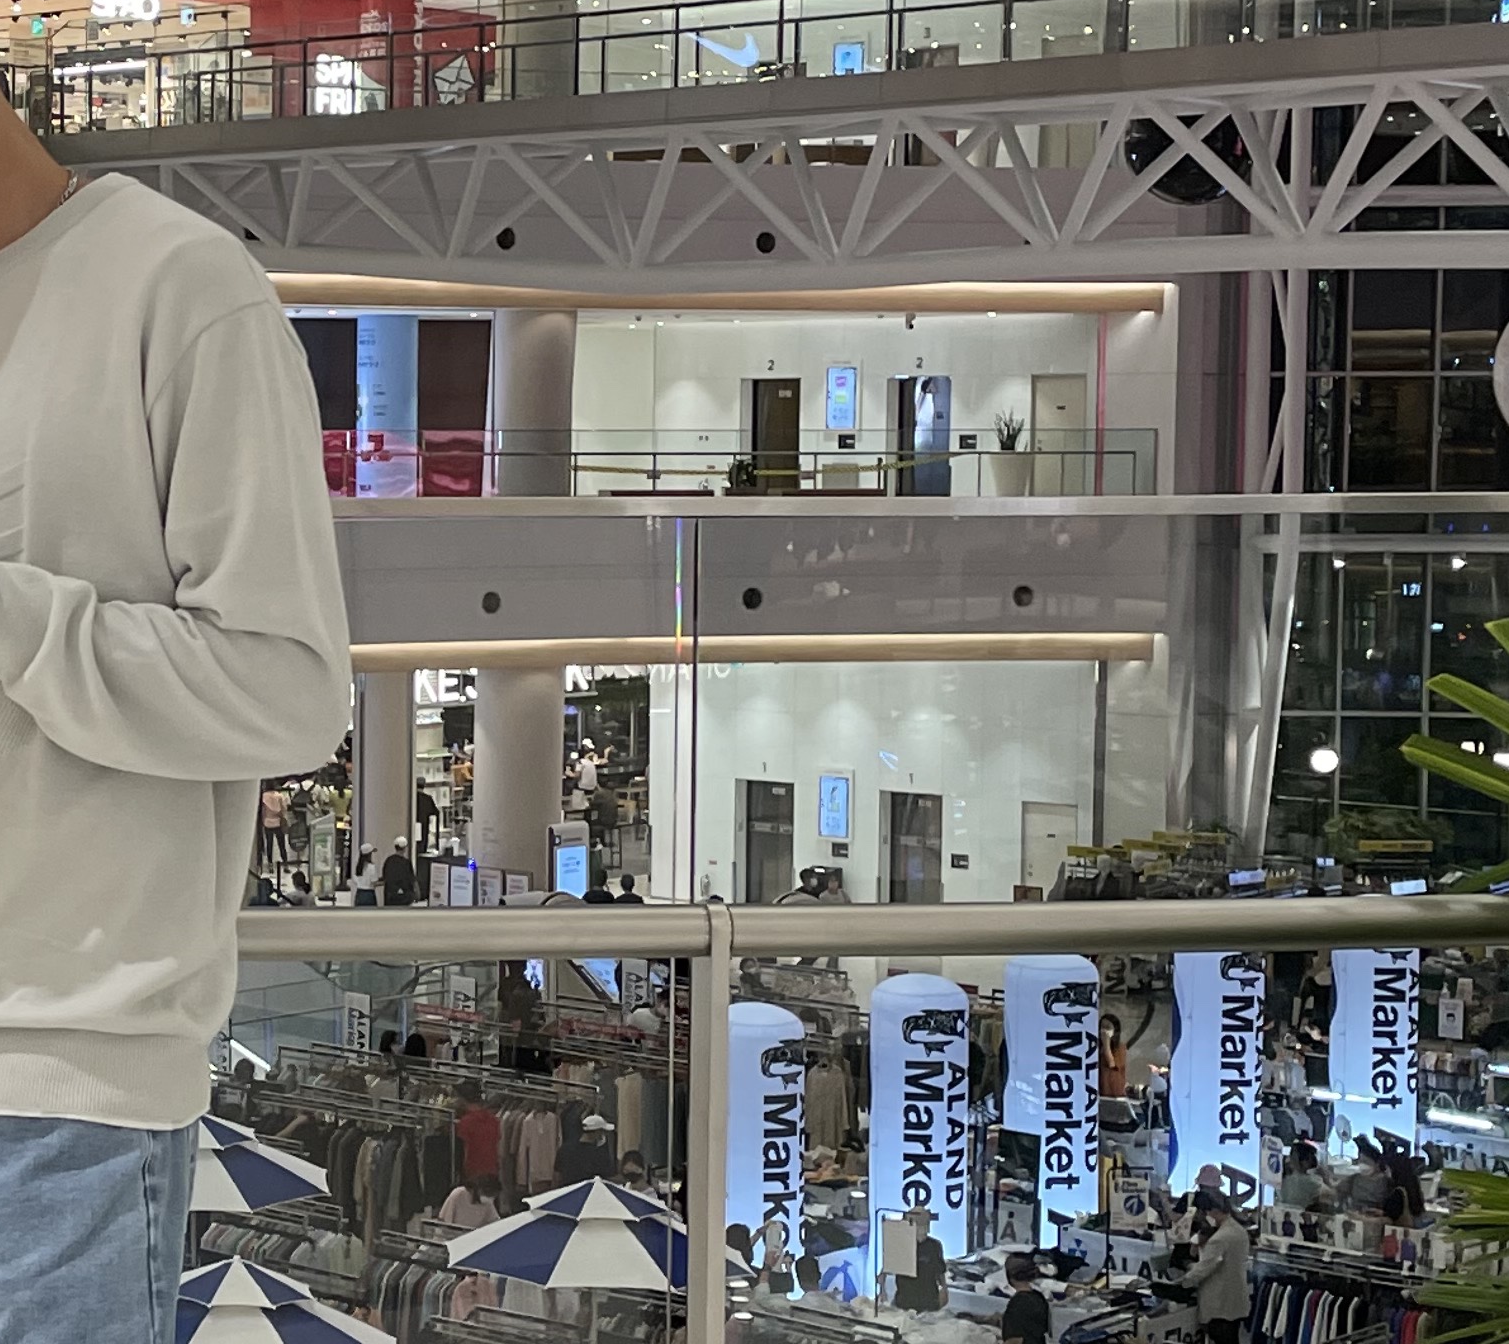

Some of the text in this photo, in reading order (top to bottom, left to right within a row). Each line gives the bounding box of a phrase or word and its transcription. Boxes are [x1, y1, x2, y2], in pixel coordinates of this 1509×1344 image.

[767, 359, 775, 371] 2
[916, 356, 923, 369] 2
[1219, 994, 1254, 1145] Market
[1371, 966, 1407, 1110] Market
[1045, 1031, 1082, 1190] Market
